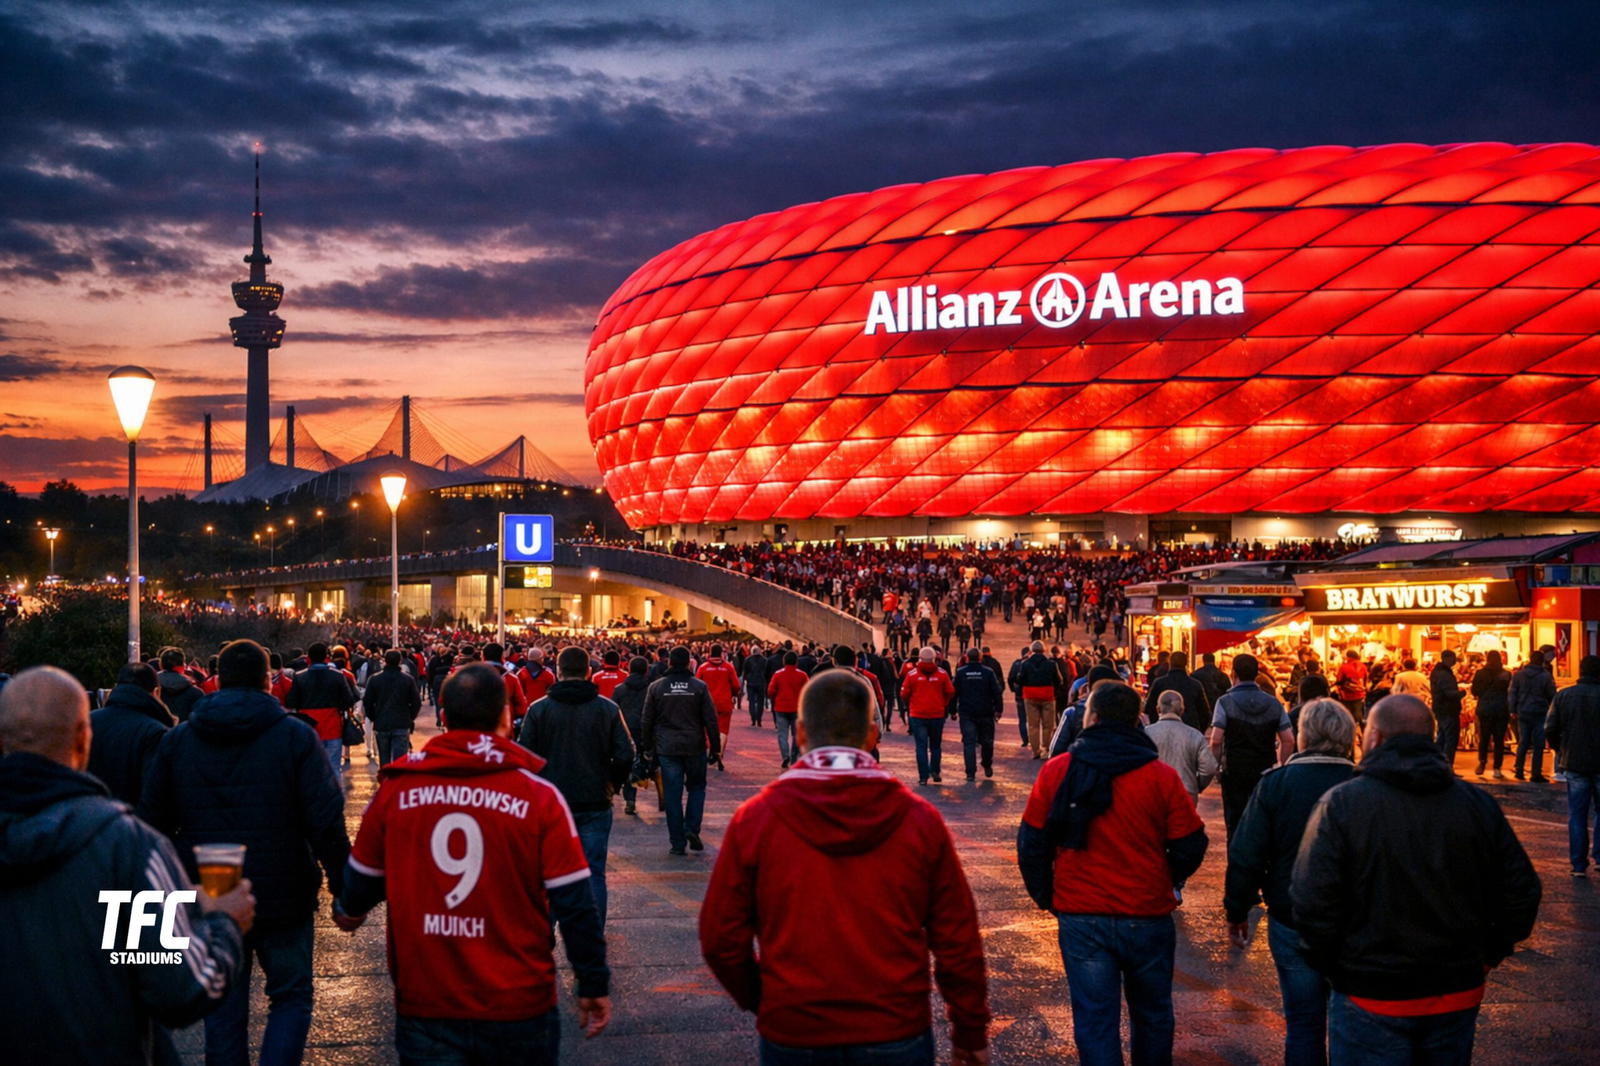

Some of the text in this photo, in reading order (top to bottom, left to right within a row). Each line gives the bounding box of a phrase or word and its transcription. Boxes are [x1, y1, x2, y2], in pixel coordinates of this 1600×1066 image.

[864, 272, 1245, 335] Allianz Arena
[515, 523, 542, 556] U
[1325, 583, 1488, 611] BRATWURST
[399, 785, 530, 819] LEWANDOWSKI
[430, 812, 484, 910] 9
